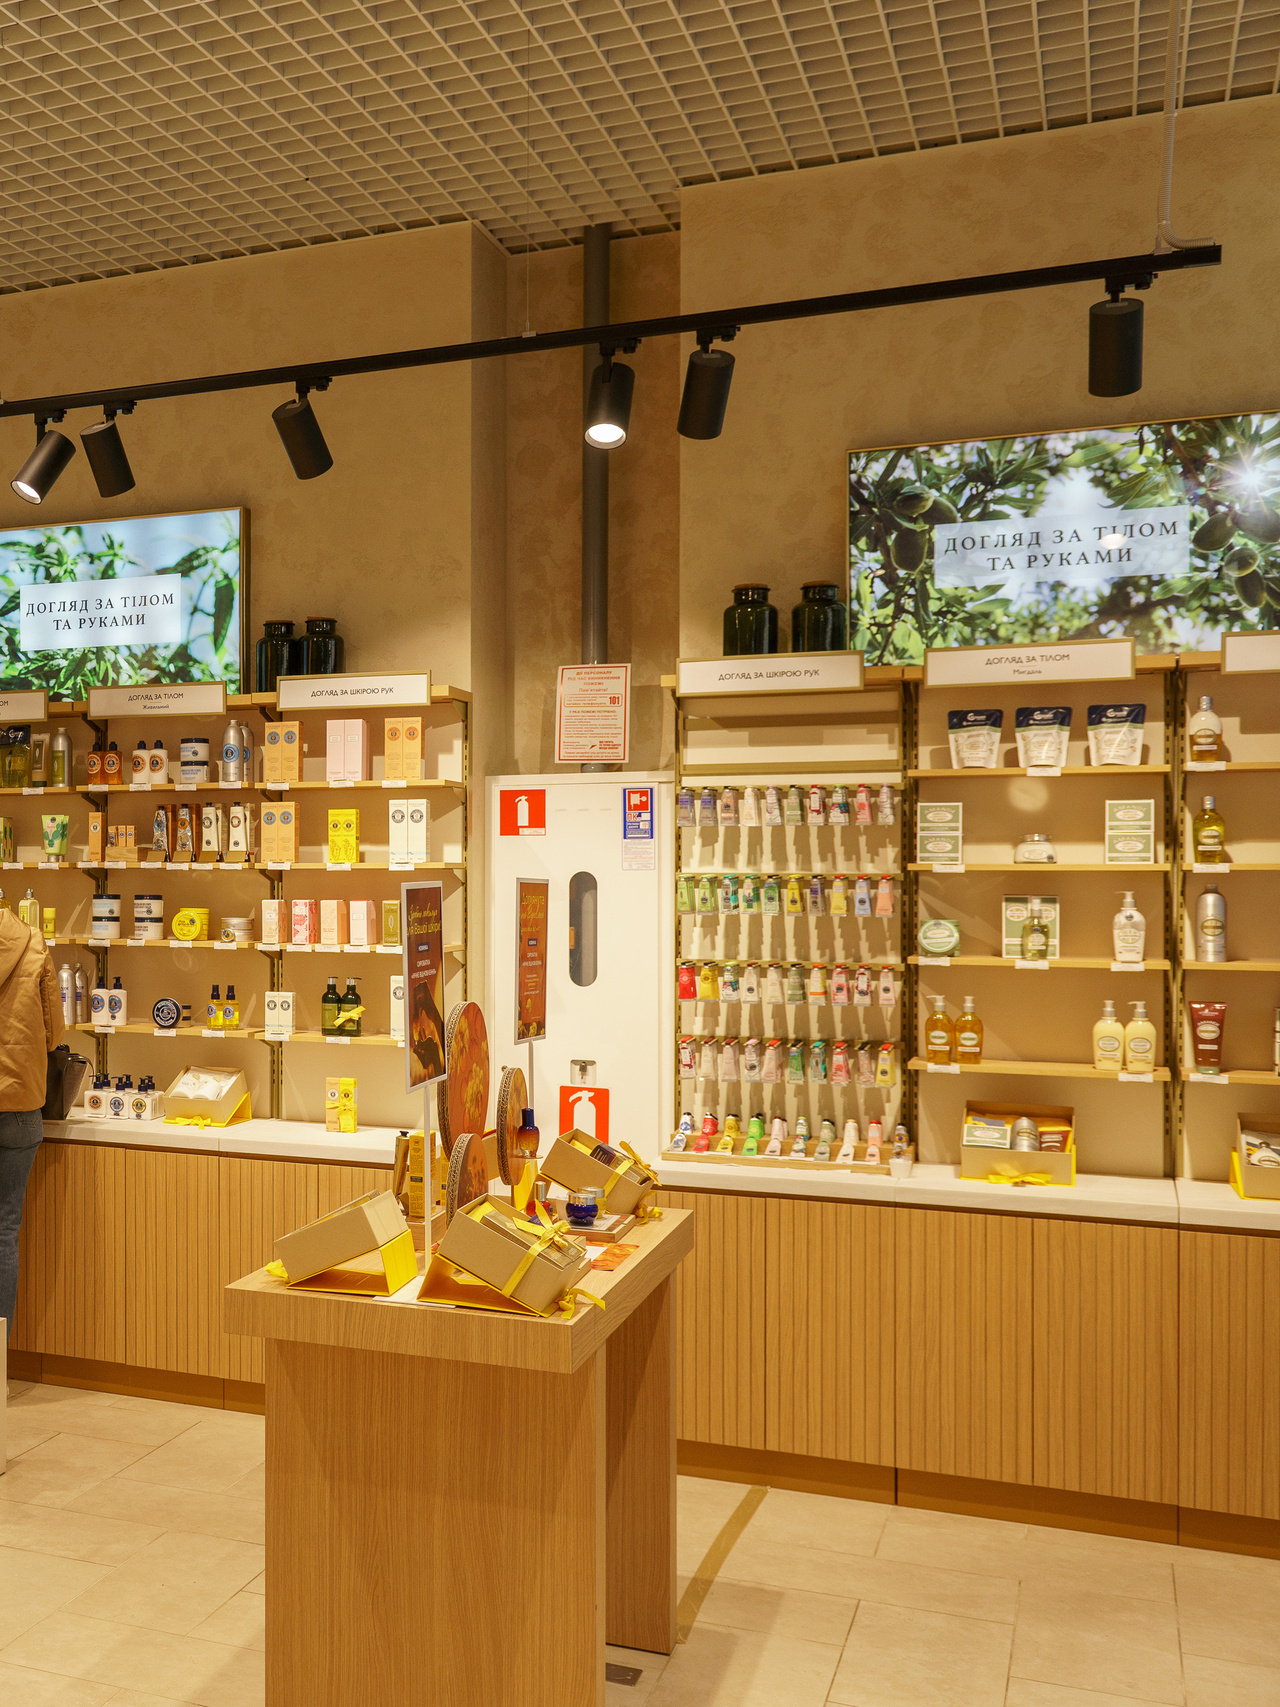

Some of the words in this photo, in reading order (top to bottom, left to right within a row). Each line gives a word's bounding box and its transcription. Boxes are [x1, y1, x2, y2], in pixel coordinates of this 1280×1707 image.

[944, 530, 1041, 555] ДОГЛЯД
[1052, 529, 1082, 544] ЗА
[1093, 521, 1178, 541] ТІЛОМ
[987, 557, 1016, 571] ТА
[1026, 548, 1133, 568] РУКАМИ
[25, 600, 89, 617] ДОГЛЯД
[95, 598, 114, 611] ЗА
[120, 592, 175, 608] ТІЛОМ
[53, 619, 71, 631] ТА
[78, 614, 146, 630] РУКАМИ
[985, 656, 1024, 665] ДОГЛЯД
[1025, 655, 1037, 663] ЗА
[1039, 653, 1070, 662] ТІЛОМ
[718, 673, 752, 681] ДОГЛЯД
[766, 670, 802, 678] ШКІРОЮ
[804, 669, 820, 678] РУК
[127, 694, 153, 702] ДОГЛЯД
[163, 692, 184, 700] ТІЛОМ
[349, 687, 380, 695] ШКІРОЮ
[381, 687, 394, 695] РУК
[608, 695, 620, 705] 101
